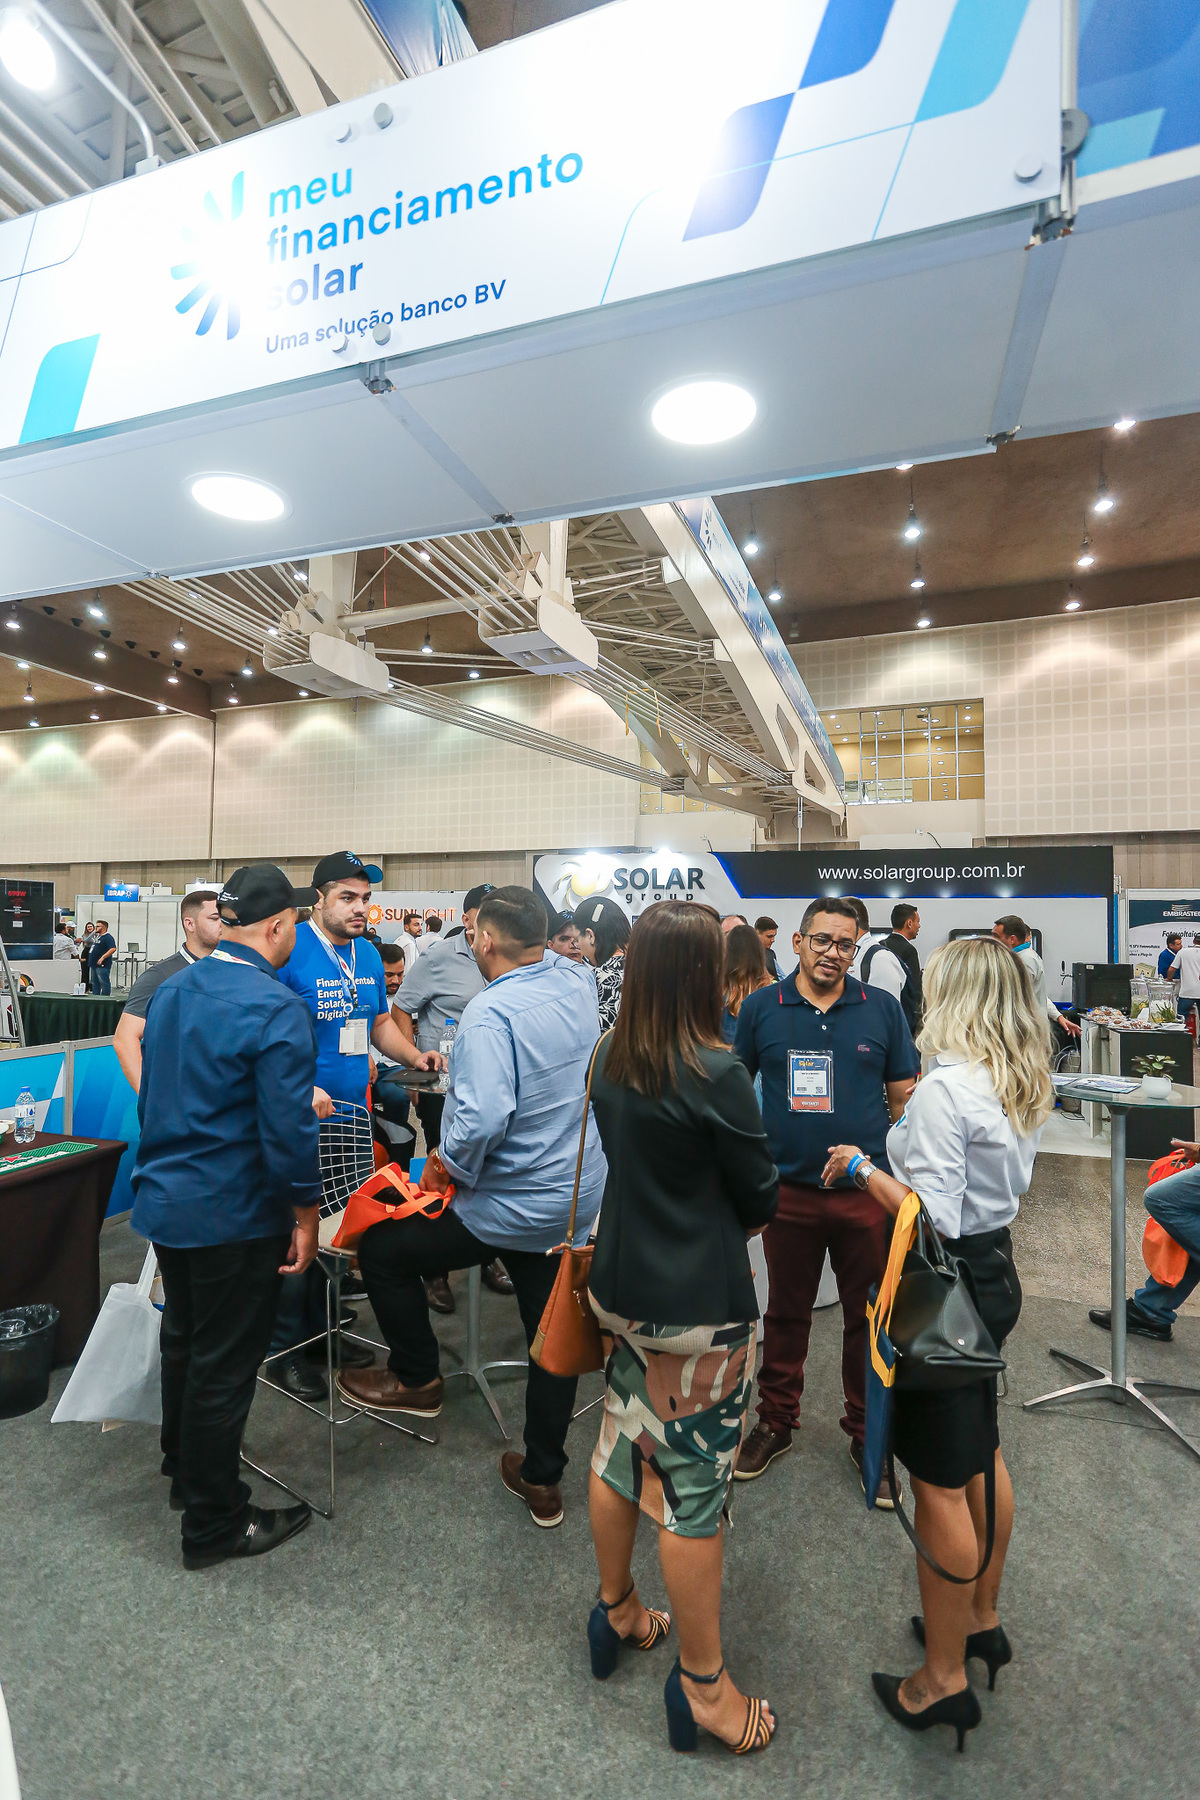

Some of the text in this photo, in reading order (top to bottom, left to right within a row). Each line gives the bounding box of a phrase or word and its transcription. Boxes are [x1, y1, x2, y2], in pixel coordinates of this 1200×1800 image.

[266, 152, 583, 264] financiamento
[269, 168, 352, 217] meu
[267, 262, 364, 311] solar
[266, 279, 506, 354] Uma solução banco BV
[614, 867, 705, 890] SOLAR
[817, 862, 1026, 883] www.solargroup.com.br
[625, 893, 694, 904] group
[317, 987, 344, 999] Energi
